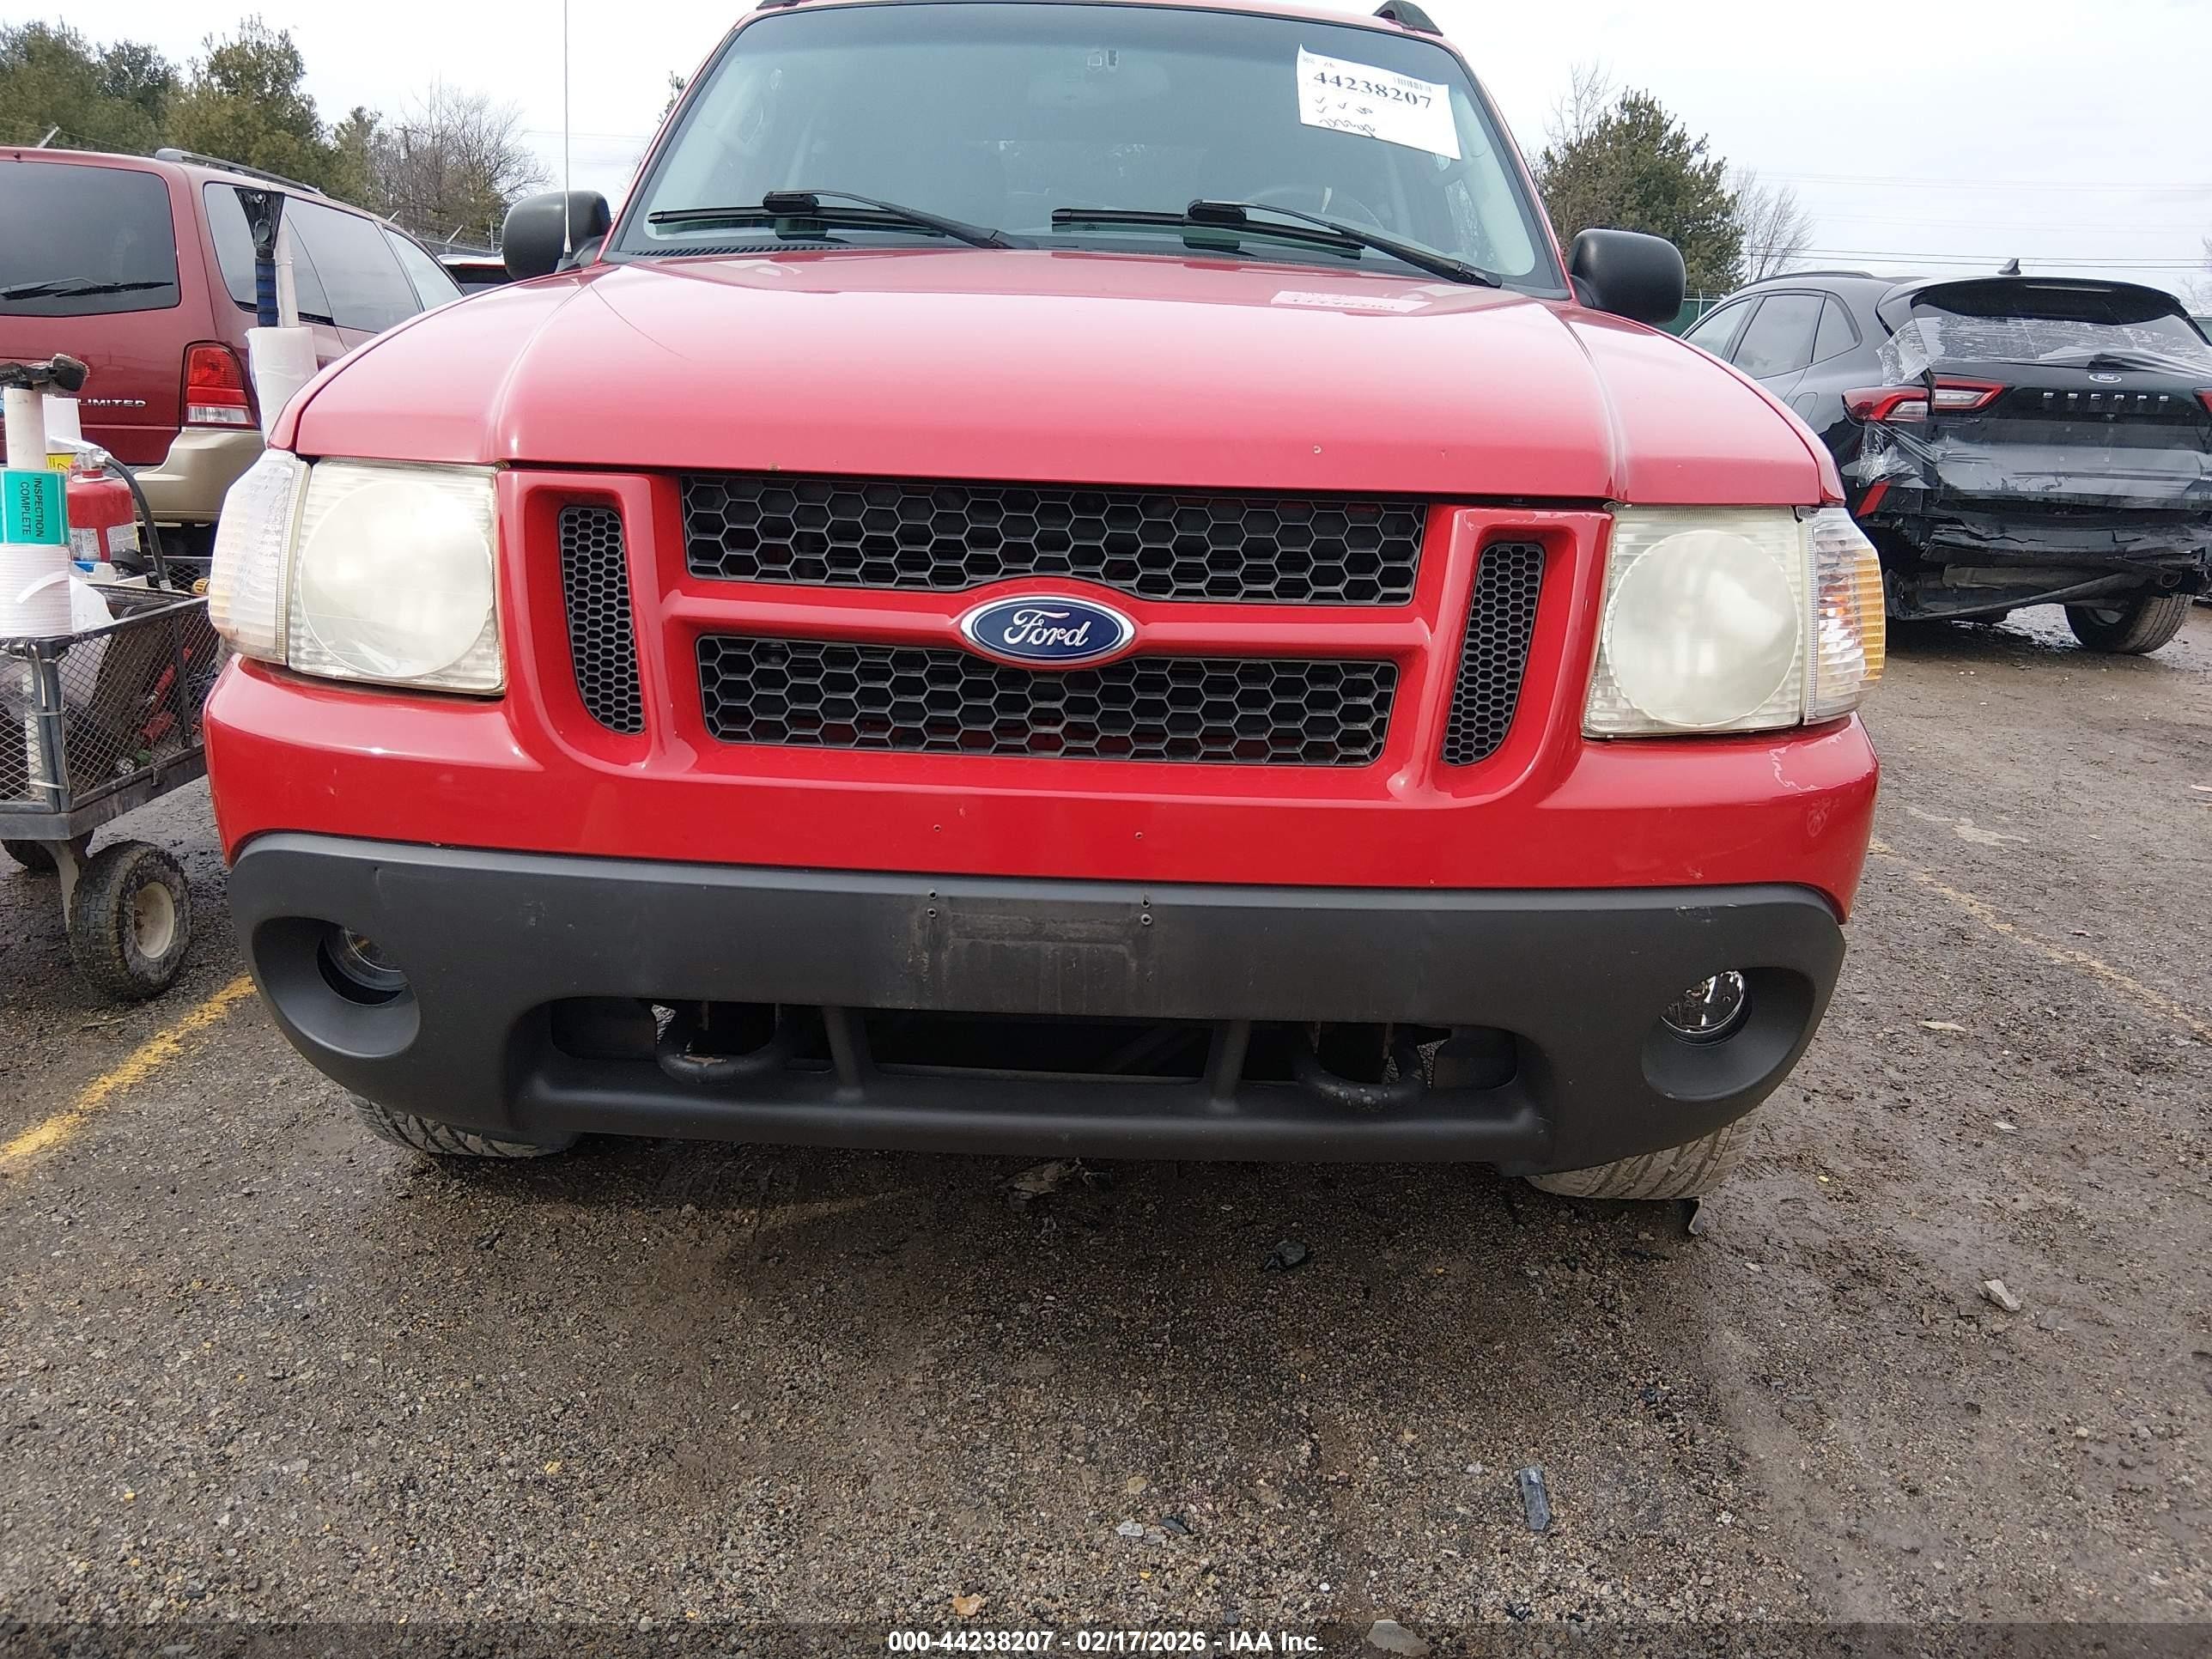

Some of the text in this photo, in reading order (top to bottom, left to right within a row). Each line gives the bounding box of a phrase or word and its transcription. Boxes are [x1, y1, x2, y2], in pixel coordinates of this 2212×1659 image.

[1314, 72, 1431, 109] 44238207
[78, 398, 147, 407] LIMITED
[2043, 392, 2169, 402] ESCAPE
[20, 481, 32, 537] COMPLETE
[33, 477, 45, 538] INSPECTION
[1003, 609, 1092, 647] Ford
